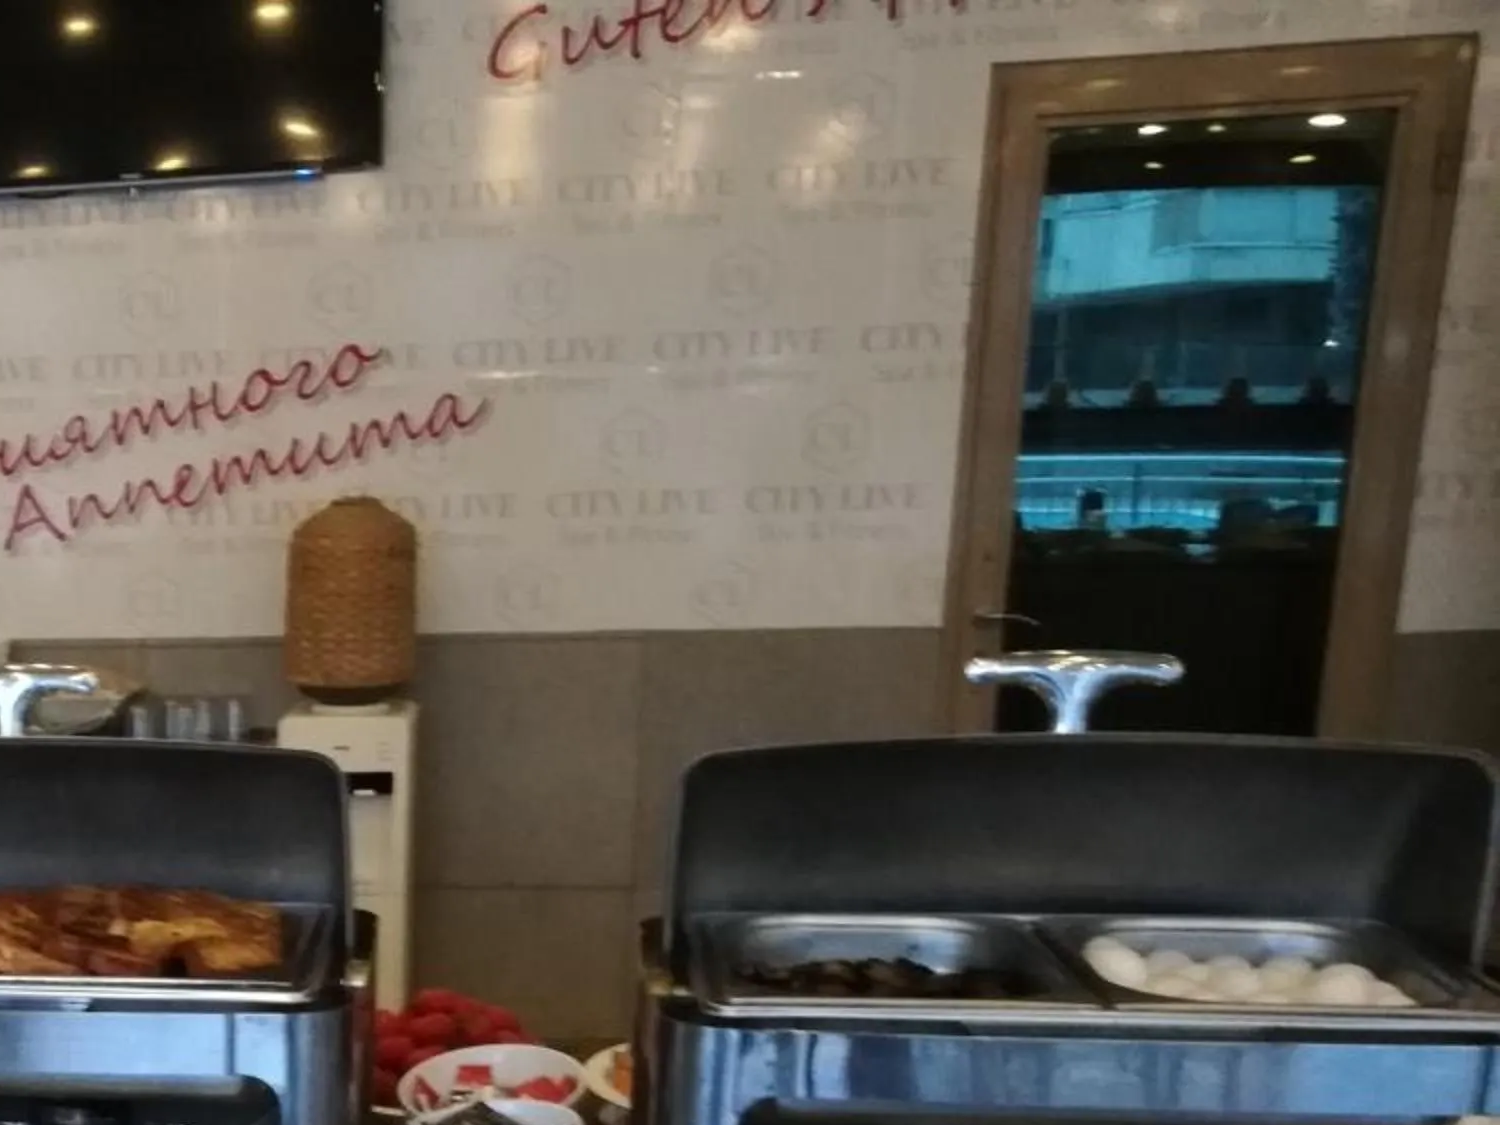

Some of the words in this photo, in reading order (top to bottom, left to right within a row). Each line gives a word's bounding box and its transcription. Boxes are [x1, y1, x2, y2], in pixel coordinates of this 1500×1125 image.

[556, 170, 635, 205] CITY
[862, 156, 957, 189] LIVE
[71, 352, 145, 382] CITY
[155, 348, 231, 378] LIVE
[451, 338, 529, 368] CITY
[543, 333, 629, 365] LIVE
[652, 329, 733, 360] CITY
[747, 324, 839, 356] LIVE
[858, 321, 944, 354] CITY
[3, 392, 490, 550] Аппетита
[439, 492, 518, 520] LIVE
[544, 489, 623, 519] CITY
[635, 486, 719, 516] LIVE
[743, 484, 826, 515] CITY
[838, 480, 932, 513] LIVE
